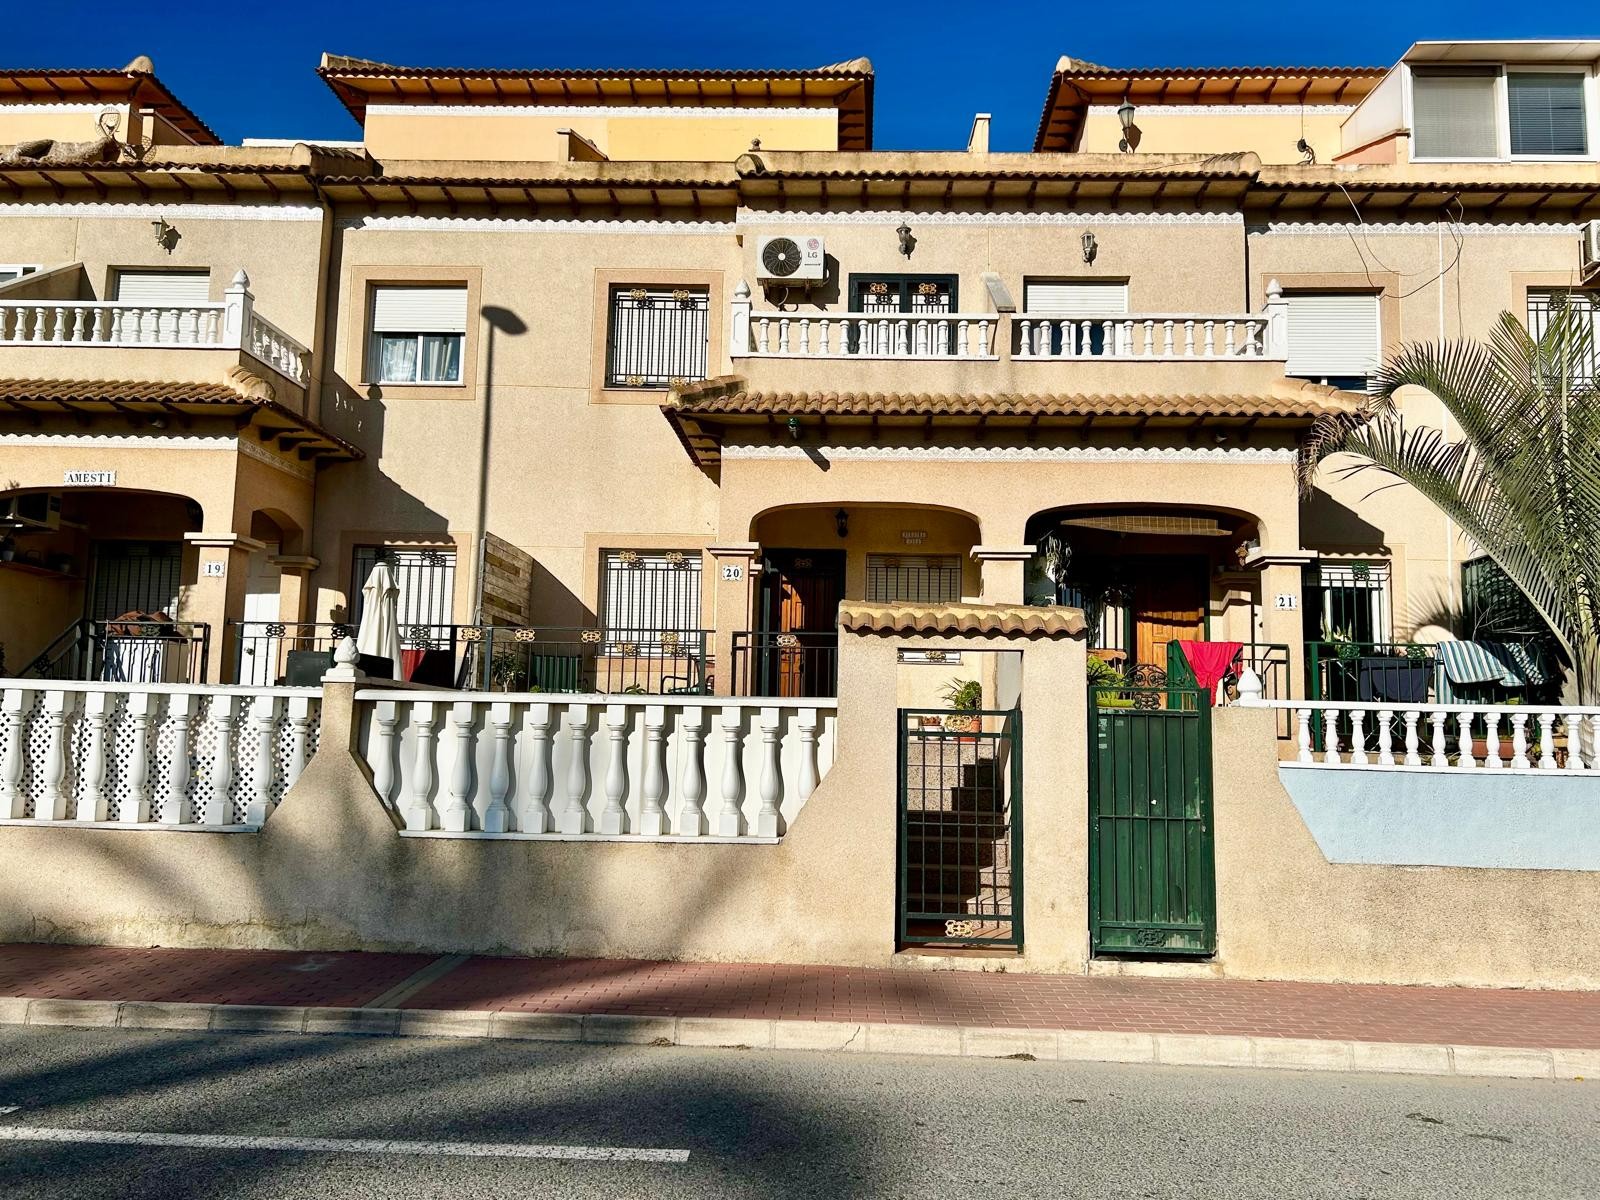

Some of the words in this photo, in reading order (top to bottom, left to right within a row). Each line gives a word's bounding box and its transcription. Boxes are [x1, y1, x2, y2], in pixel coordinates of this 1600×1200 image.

[68, 473, 111, 483] AMESTI
[207, 564, 221, 574] 19
[725, 568, 740, 578] 20
[1278, 596, 1293, 607] 21
